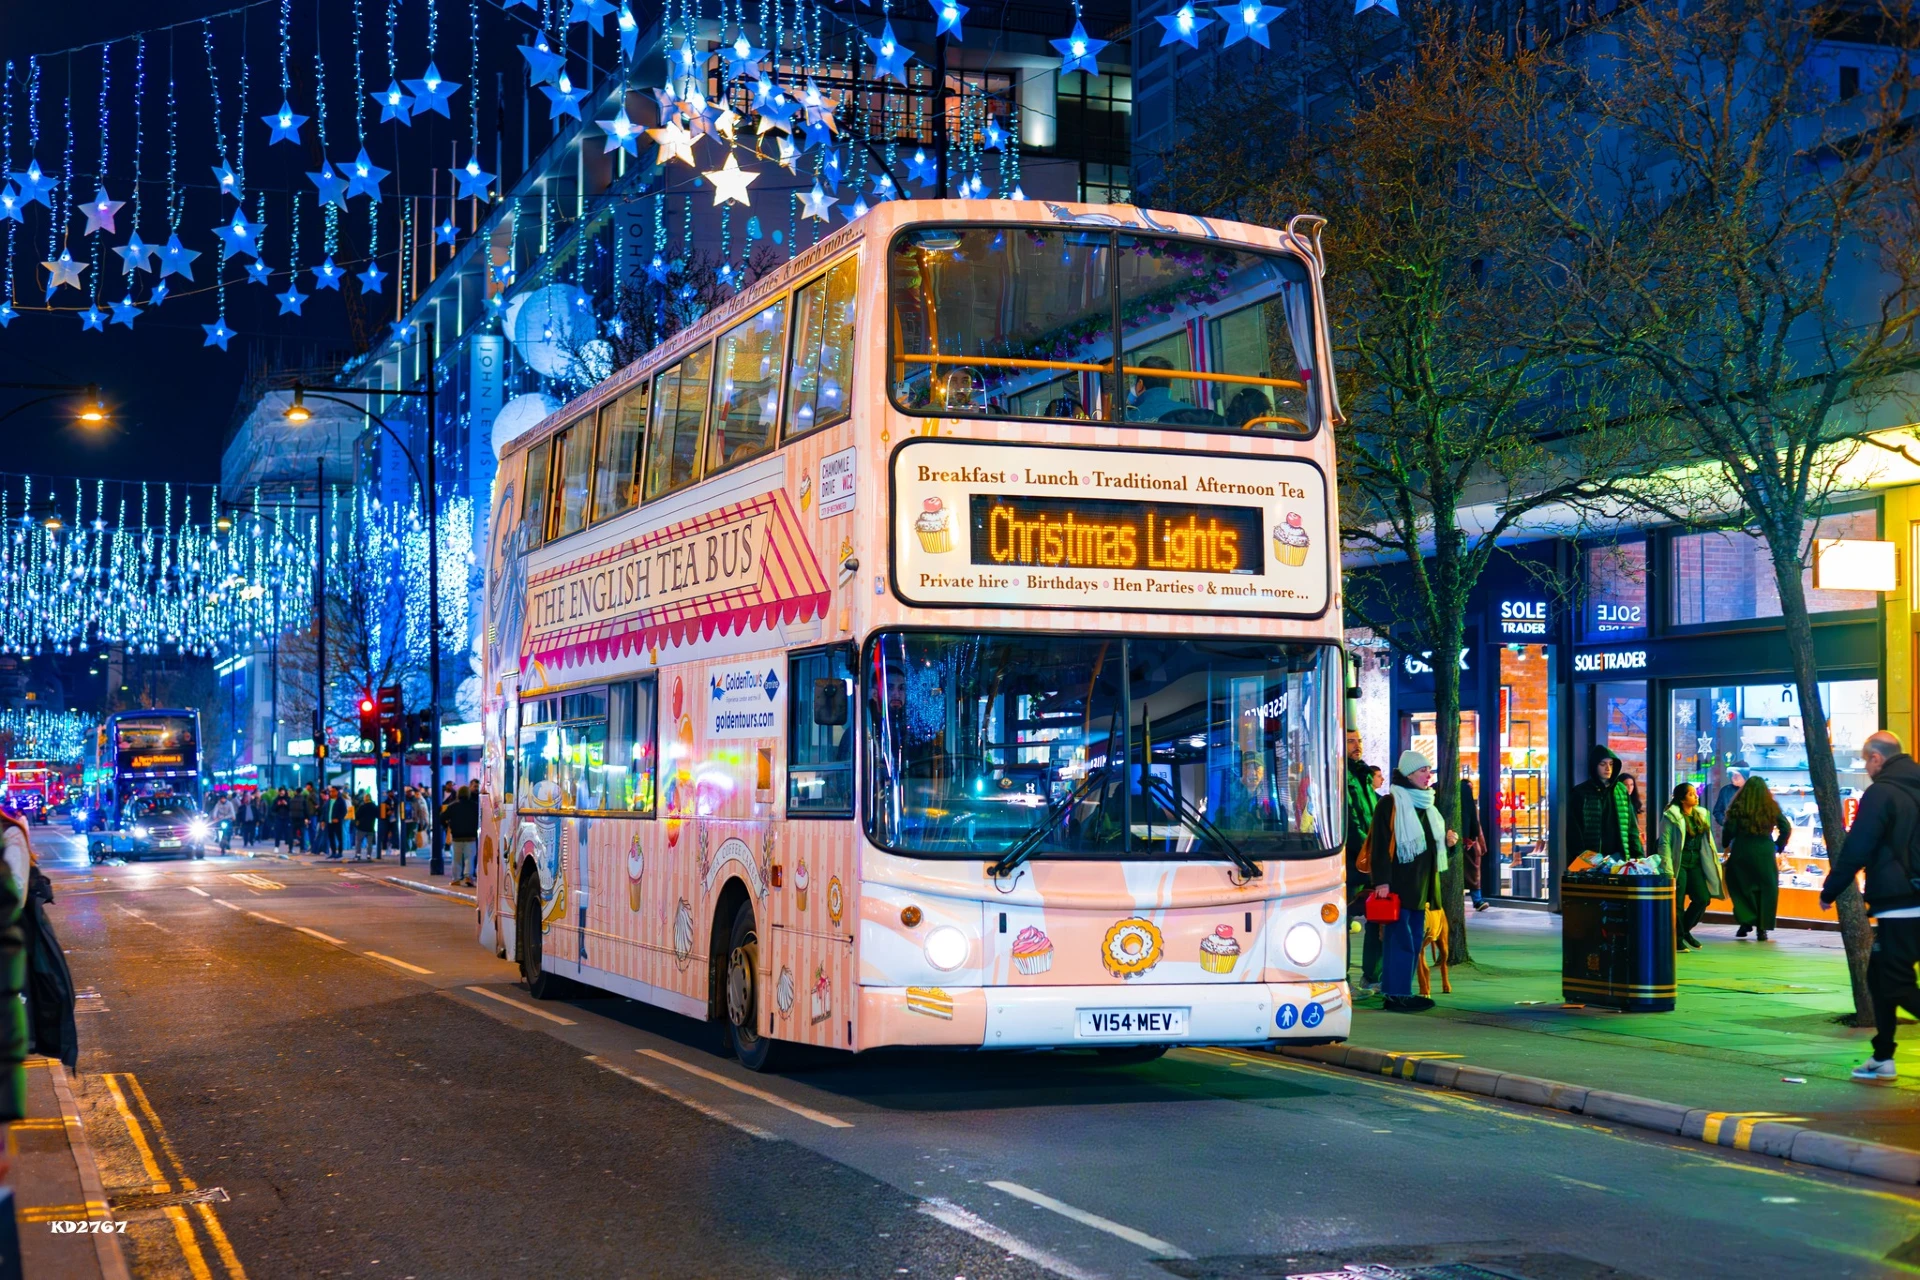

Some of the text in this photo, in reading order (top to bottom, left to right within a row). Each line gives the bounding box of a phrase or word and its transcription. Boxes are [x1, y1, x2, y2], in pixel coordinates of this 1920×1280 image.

[627, 212, 643, 278] JOHN
[729, 299, 745, 315] Hen
[749, 273, 779, 303] Parties
[783, 263, 792, 280] &
[794, 247, 822, 274] much
[479, 347, 492, 398] JOHN
[480, 407, 492, 467] LEWIS
[917, 465, 1306, 499] Breakfast Lunch Traditional Afternoon Tea
[988, 506, 1239, 571] Christmas Lights
[534, 523, 753, 628] THE ENGLISH TEA BUS
[919, 573, 975, 589] Private
[978, 574, 1009, 590] hire
[1027, 575, 1098, 593] Birthdays
[1113, 578, 1142, 592] Hen
[1146, 578, 1195, 595] Parties
[1206, 581, 1218, 595] &
[1221, 583, 1257, 597] much
[1501, 601, 1546, 619] SOLE
[1502, 622, 1546, 634] TRADER
[716, 710, 775, 733] goldentours.com
[1495, 791, 1526, 810] SALE
[1092, 1013, 1172, 1032] V154 MEV
